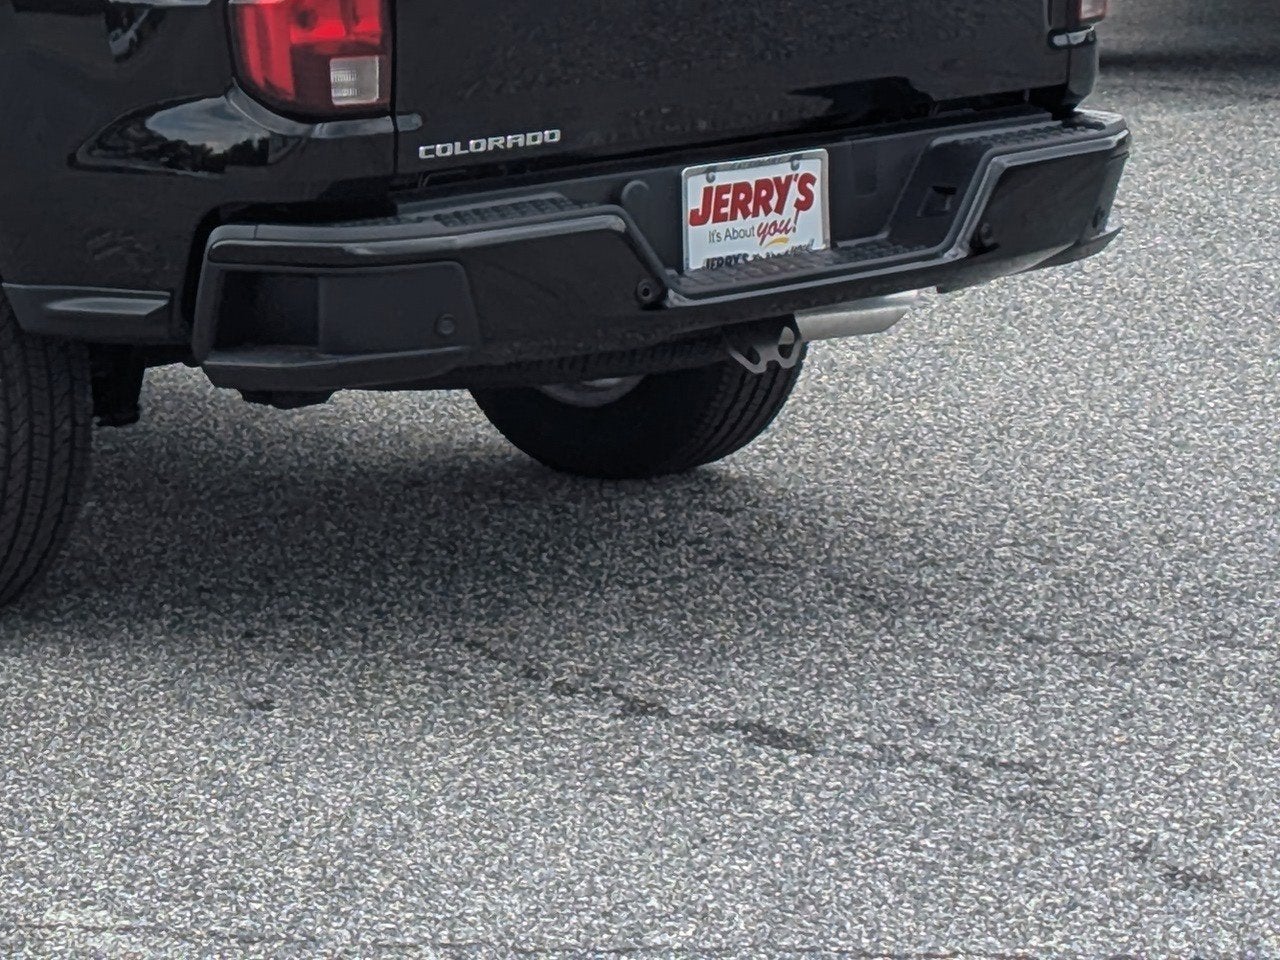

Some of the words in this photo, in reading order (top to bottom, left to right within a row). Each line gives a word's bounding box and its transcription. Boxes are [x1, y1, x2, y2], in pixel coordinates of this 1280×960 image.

[418, 129, 562, 159] COLORADO
[688, 172, 817, 227] JERRY'S
[708, 229, 722, 244] It's
[724, 226, 755, 242] About
[756, 211, 801, 246] you!
